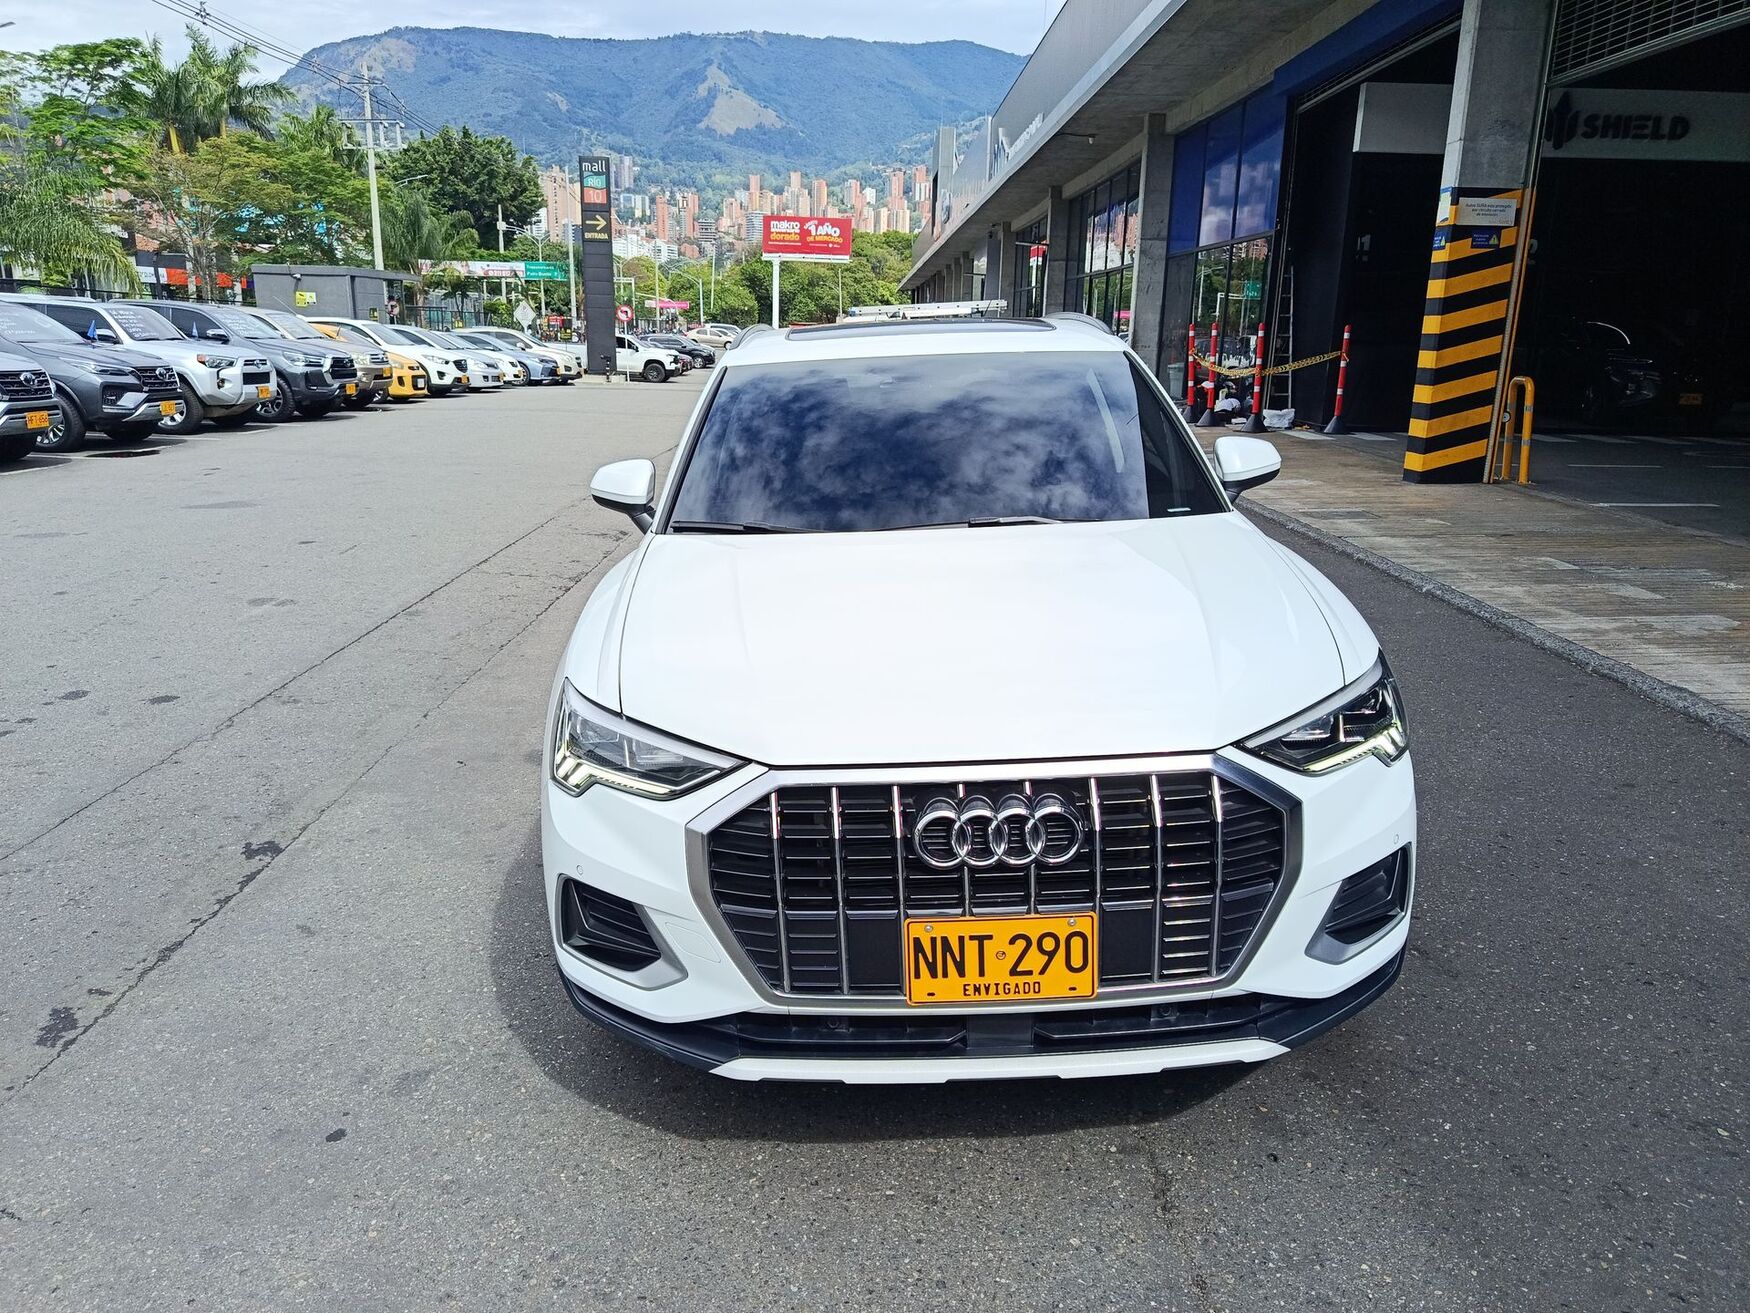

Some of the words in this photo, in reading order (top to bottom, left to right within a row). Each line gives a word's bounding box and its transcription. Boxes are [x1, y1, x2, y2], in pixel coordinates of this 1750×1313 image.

[1581, 113, 1690, 141] SHIELD
[582, 160, 606, 172] mall
[589, 189, 602, 201] 10
[770, 220, 800, 229] makro
[817, 222, 841, 237] AÑO
[584, 232, 608, 240] ENTRADA
[770, 232, 800, 240] dorado
[815, 235, 844, 244] MERCADO
[912, 934, 994, 980] NNT
[1008, 930, 1089, 977] 290
[962, 981, 1041, 997] ENVIGADO
